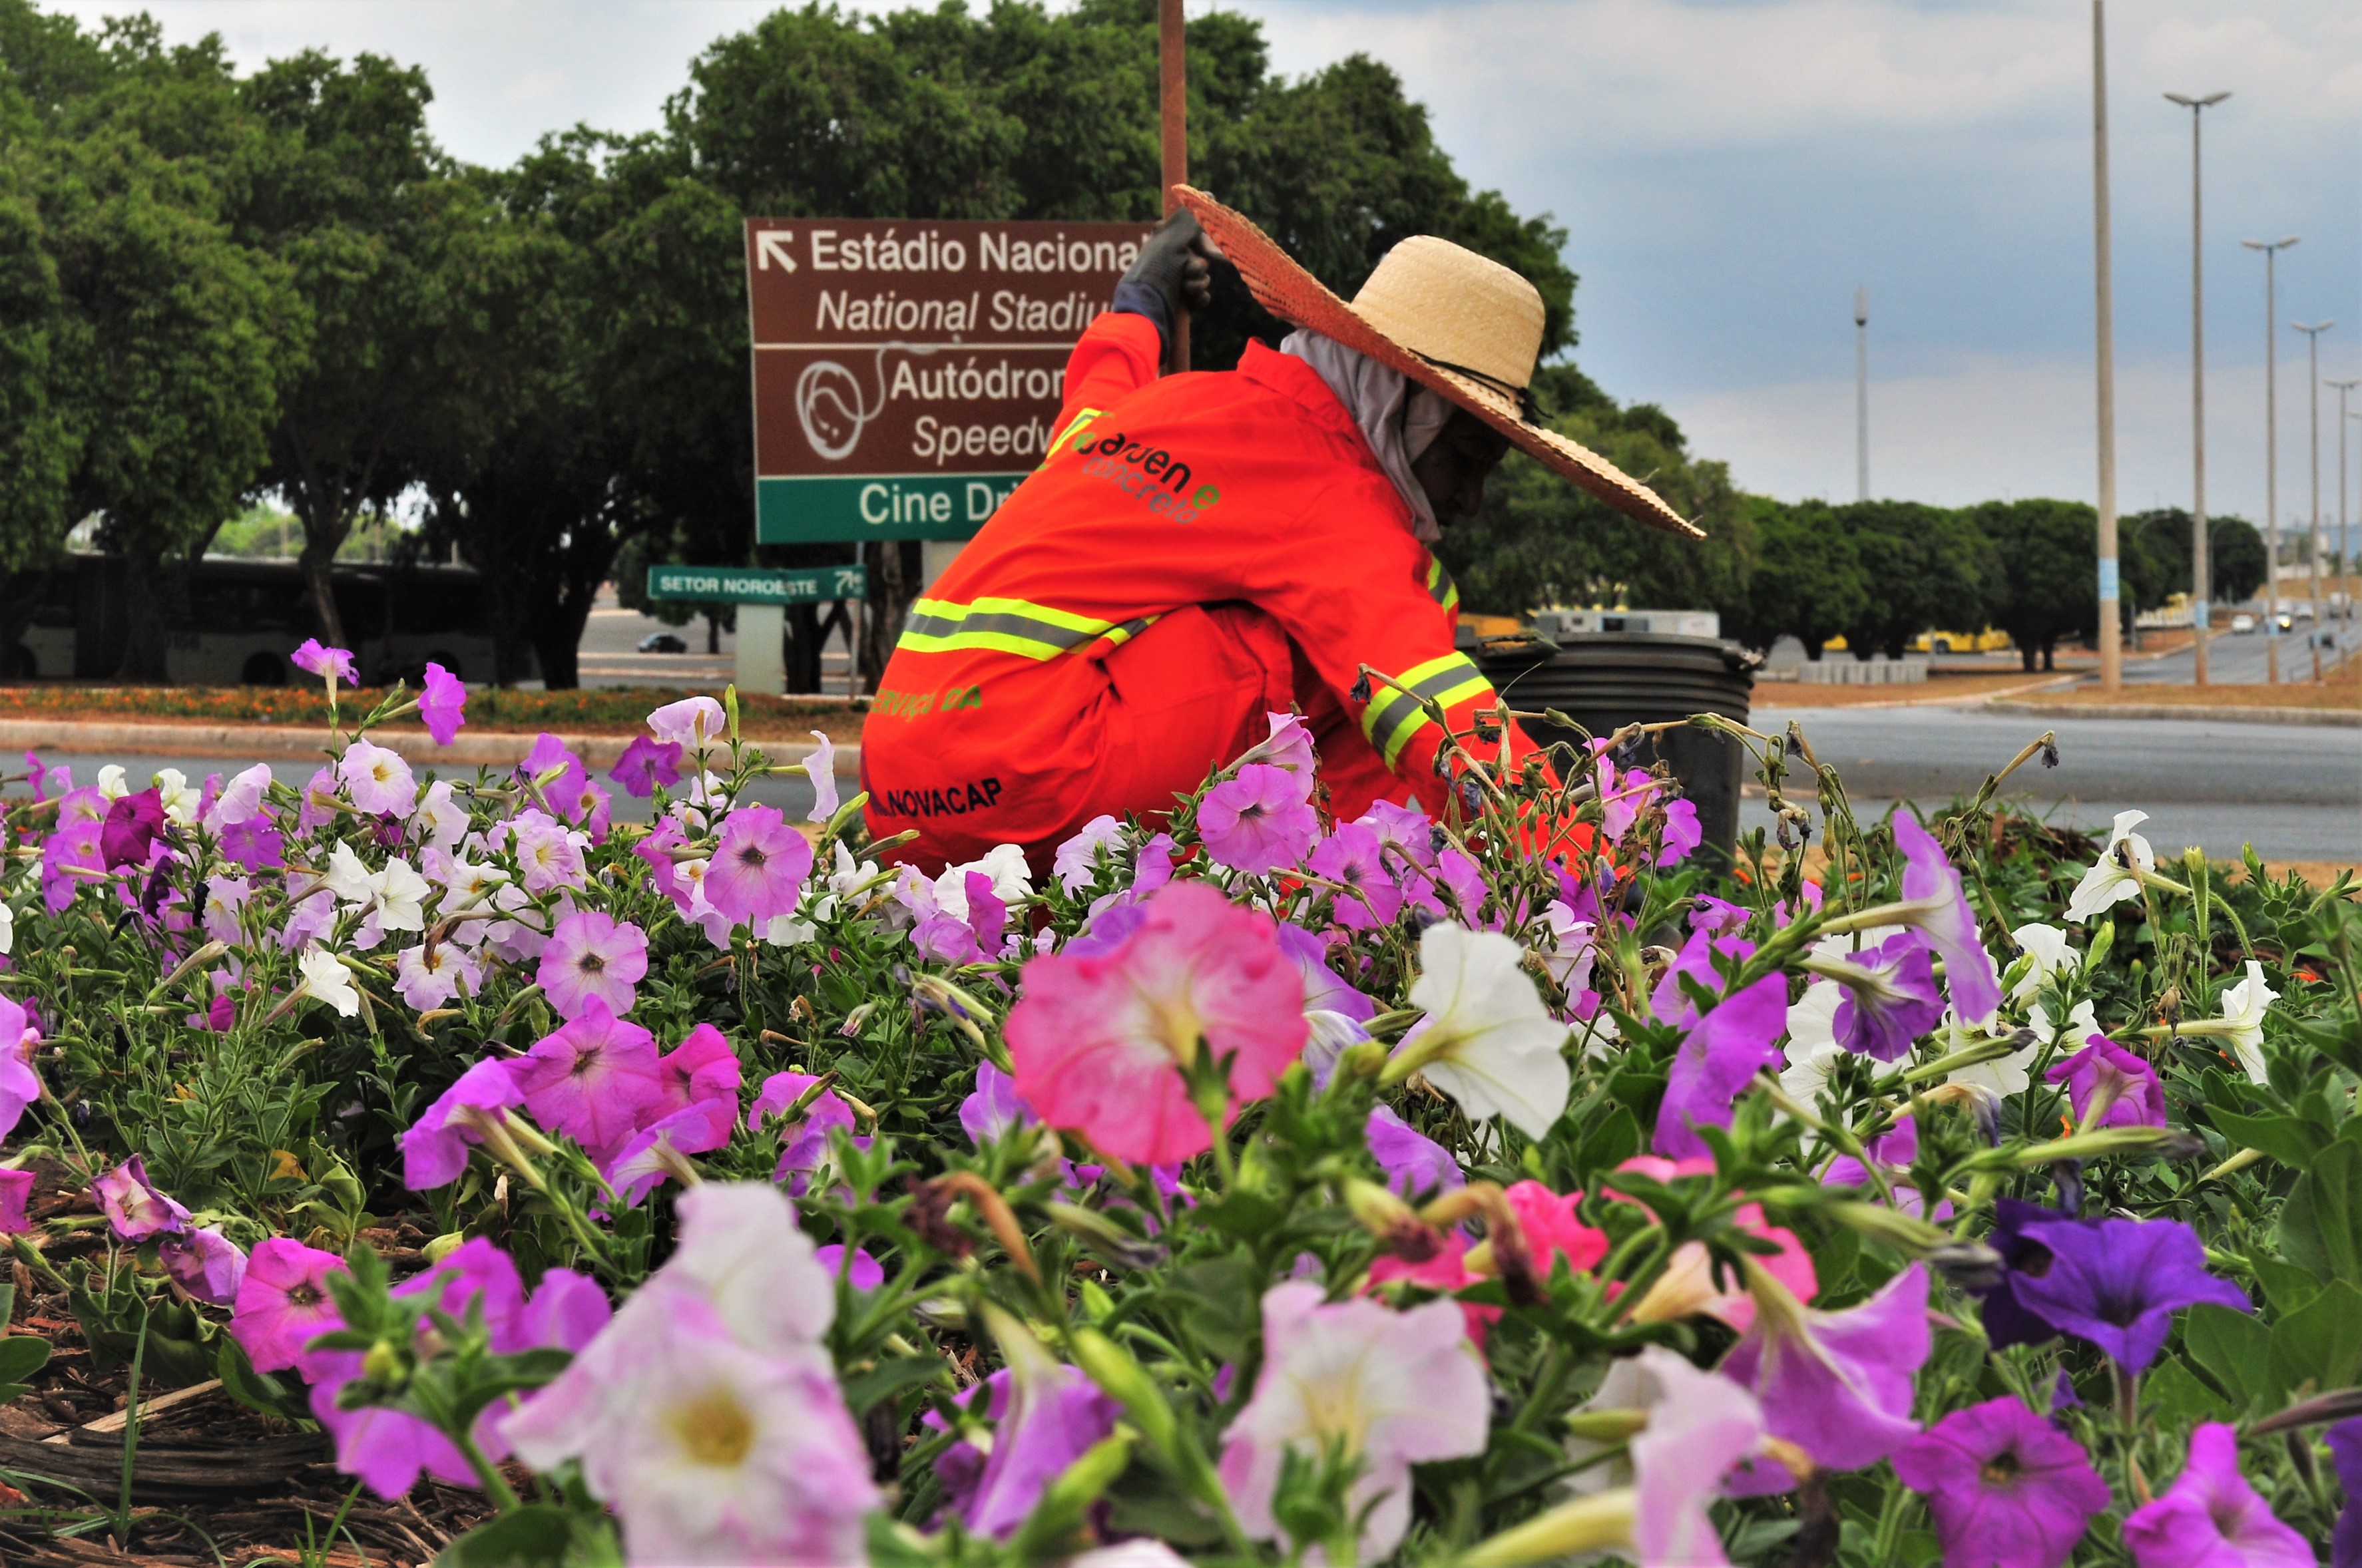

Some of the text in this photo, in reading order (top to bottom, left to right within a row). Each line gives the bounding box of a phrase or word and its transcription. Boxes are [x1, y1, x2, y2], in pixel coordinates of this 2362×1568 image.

[812, 228, 1151, 272] Estádio Naciona
[817, 290, 1114, 331] National Stadiu
[860, 483, 951, 524] Cine
[660, 576, 818, 596] SETOR NOROESTE
[870, 684, 982, 722] ERVIÇO DA
[886, 777, 1003, 818] NOVACAP
